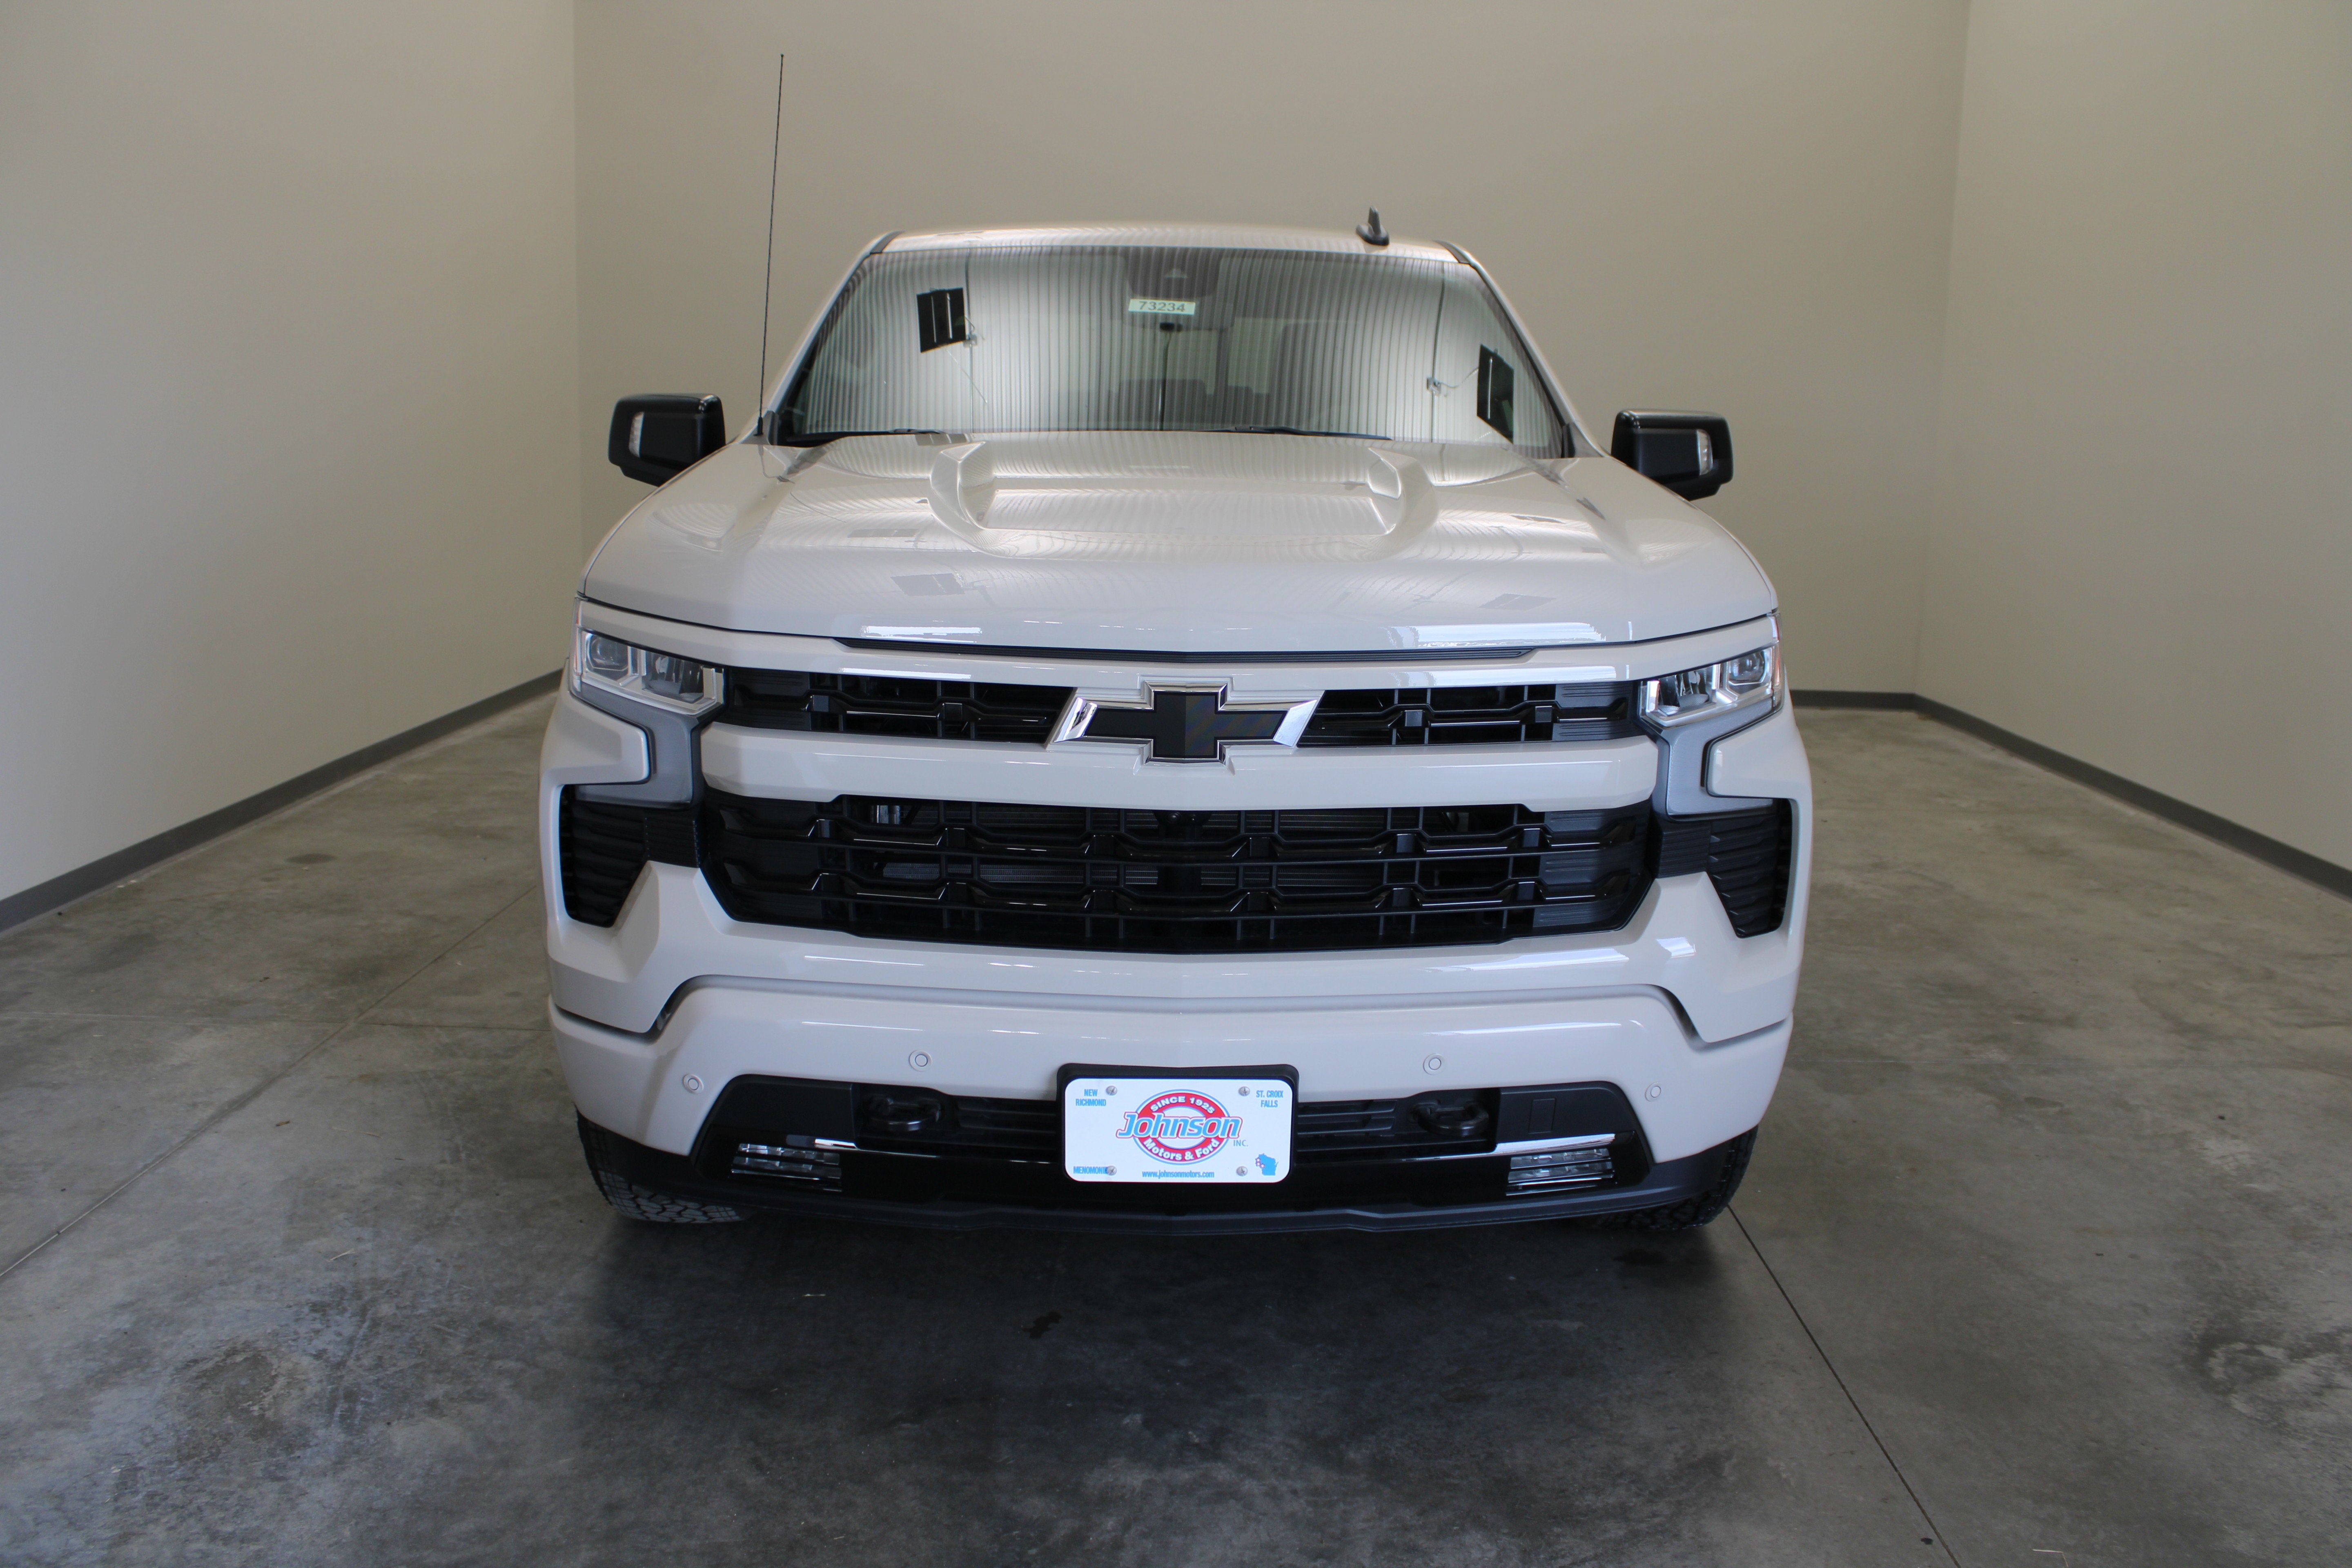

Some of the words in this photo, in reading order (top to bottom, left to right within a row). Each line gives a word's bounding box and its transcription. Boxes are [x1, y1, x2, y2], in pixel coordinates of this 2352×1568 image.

[1139, 301, 1185, 312] 73234
[1267, 1090, 1283, 1098] CROIX
[1150, 1096, 1185, 1112] SINCE
[1189, 1097, 1216, 1114] 1925
[1118, 1113, 1241, 1137] Johnson
[1144, 1138, 1182, 1160] Motors
[1185, 1152, 1194, 1160] &
[1195, 1139, 1219, 1158] Ford
[1142, 1170, 1214, 1179] www.johnsonmotors.com
